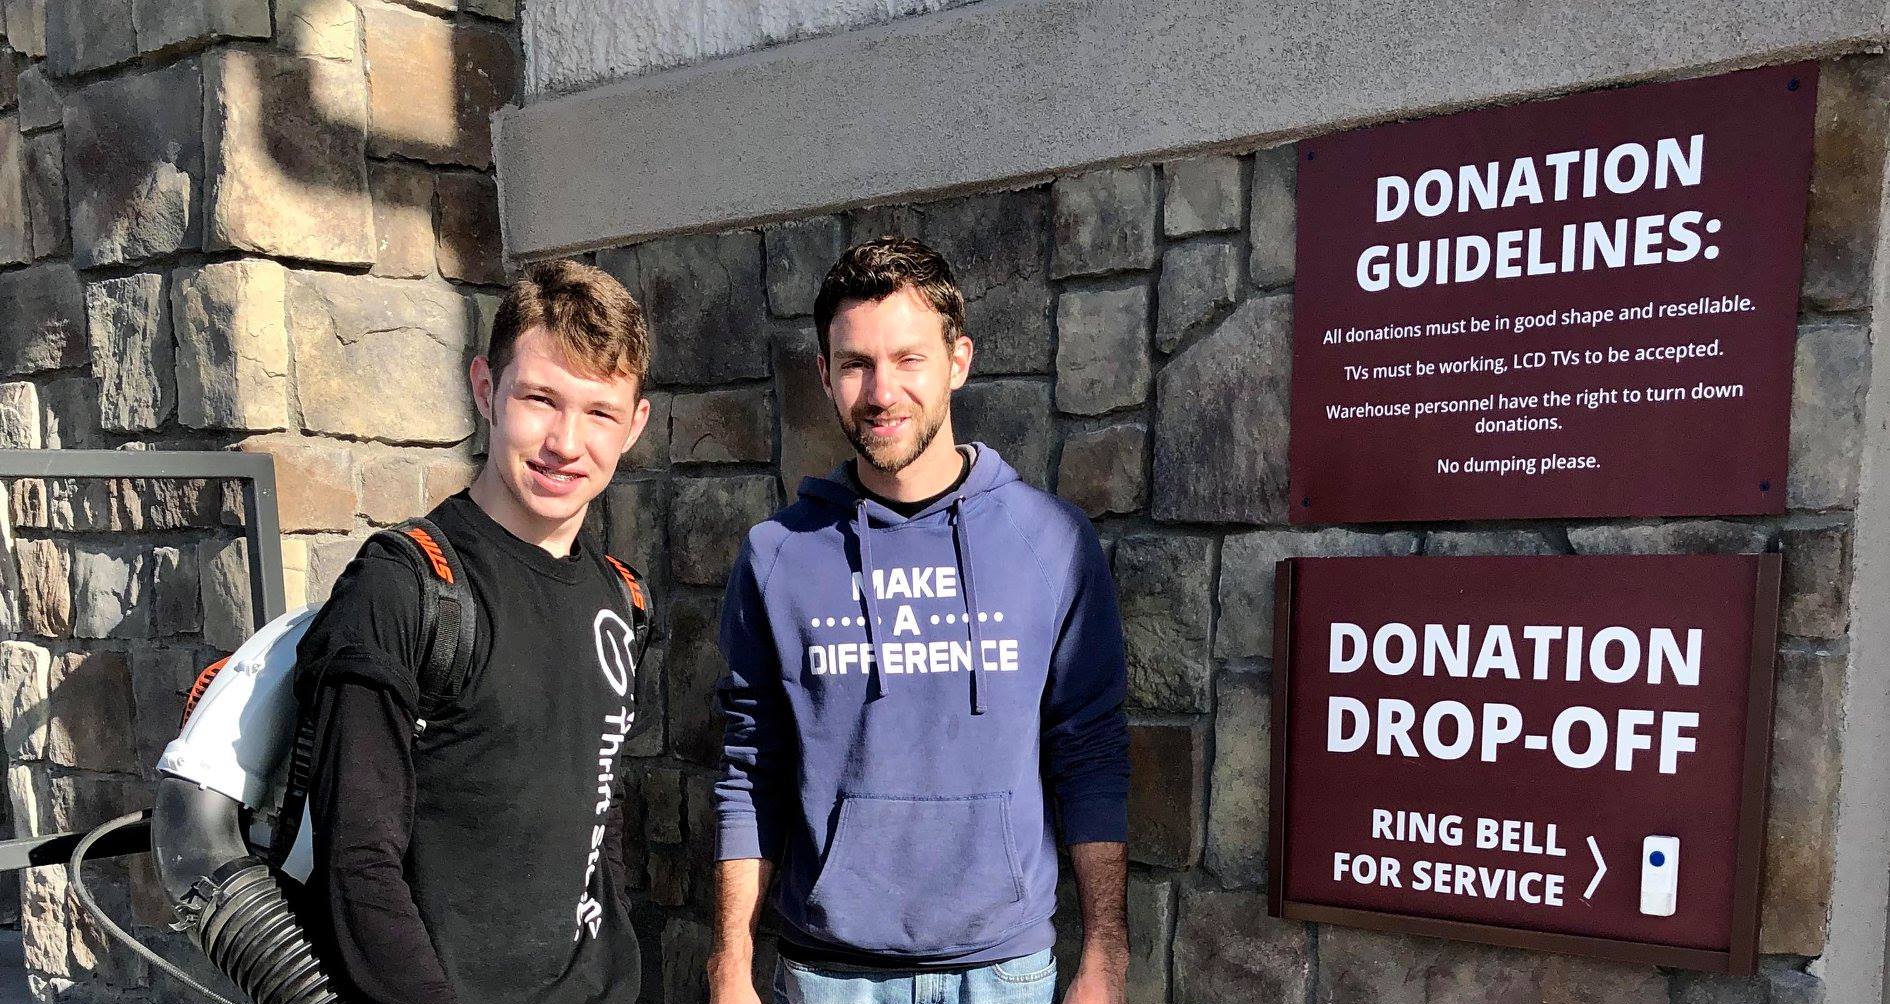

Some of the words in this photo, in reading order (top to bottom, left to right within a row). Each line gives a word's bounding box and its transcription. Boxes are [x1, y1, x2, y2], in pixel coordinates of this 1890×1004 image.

[1375, 133, 1704, 223] DONATION
[1356, 210, 1722, 293] GUIDELINES:
[1322, 328, 1342, 345] All
[1345, 323, 1422, 343] donations
[1425, 319, 1467, 337] must
[1470, 316, 1491, 333] be
[1495, 314, 1510, 331] in
[1513, 309, 1557, 334] good
[1560, 308, 1615, 328] shape
[1618, 301, 1654, 321] and
[1658, 294, 1756, 318] resellable.
[1343, 365, 1369, 381] TVs
[1373, 362, 1412, 379] must
[1415, 359, 1435, 376] be
[1438, 355, 1508, 375] working,
[1513, 352, 1547, 369] LCD
[1550, 349, 1580, 367] TVs
[1584, 349, 1603, 365] to
[1607, 346, 1630, 363] be
[1634, 338, 1724, 364] accepted.
[1325, 401, 1411, 420] Warehouse
[1414, 394, 1494, 419] personnel
[1498, 393, 1539, 410] have
[1542, 390, 1572, 408] the
[1576, 387, 1619, 410] right
[1622, 388, 1642, 403] to
[1645, 386, 1686, 402] turn
[1690, 381, 1744, 400] down
[1474, 415, 1563, 434] donations.
[1437, 458, 1460, 474] No
[1463, 455, 1537, 477] dumping
[1540, 453, 1601, 475] please.
[851, 566, 957, 601] MAKE
[892, 604, 921, 637] A
[808, 639, 1019, 675] DIFFERENCE
[1329, 622, 1703, 686] DONATION
[1327, 695, 1700, 775] DROP-OFF
[1371, 808, 1464, 847] RING
[1476, 817, 1567, 857] BELL
[1333, 851, 1403, 889] FOR
[1411, 860, 1565, 907] SERVICE
